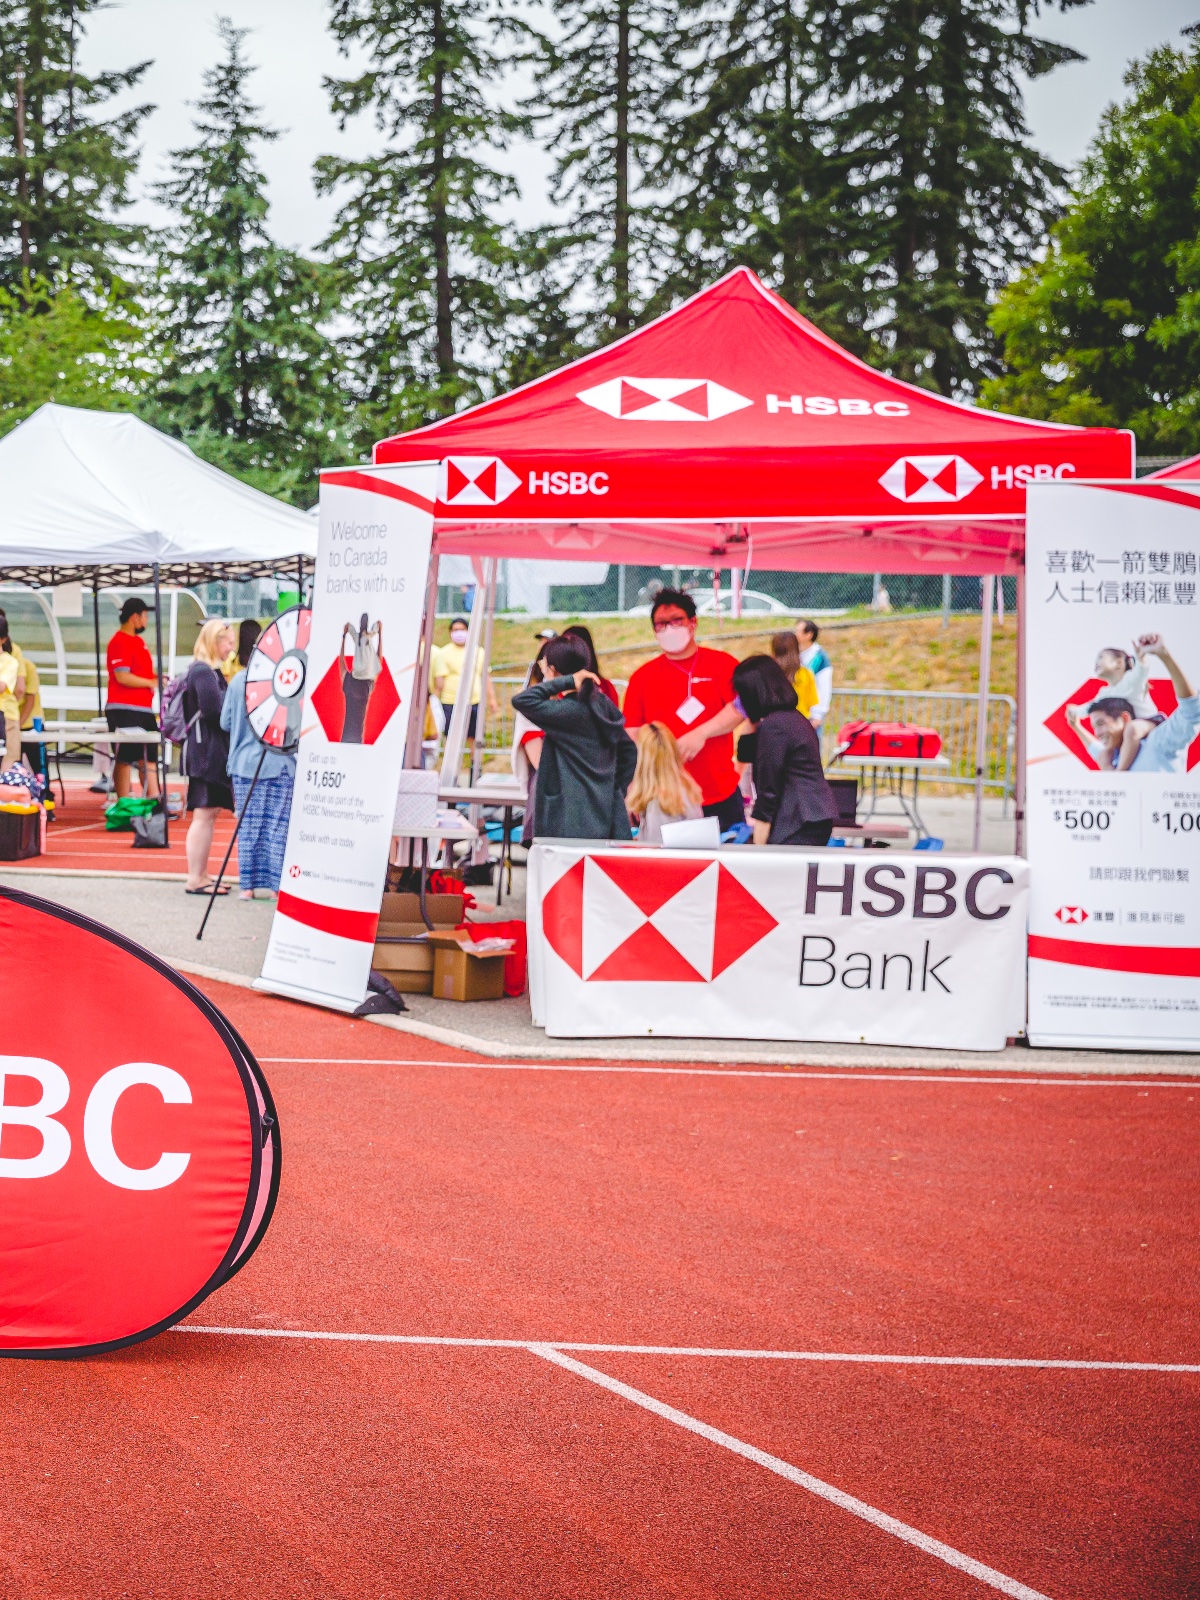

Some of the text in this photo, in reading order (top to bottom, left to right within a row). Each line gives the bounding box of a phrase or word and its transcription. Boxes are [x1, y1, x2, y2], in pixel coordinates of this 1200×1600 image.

[766, 393, 911, 417] HSBC
[528, 470, 610, 496] HSBC
[990, 462, 1077, 490] HSBC
[330, 521, 388, 541] Welcome
[328, 546, 388, 568] to Canada
[1045, 549, 1200, 576] 喜歡一箭雙鵰
[326, 573, 406, 594] banks with us
[1151, 811, 1200, 835] $1,0
[804, 862, 1014, 921] HSBC
[798, 934, 953, 994] Bank
